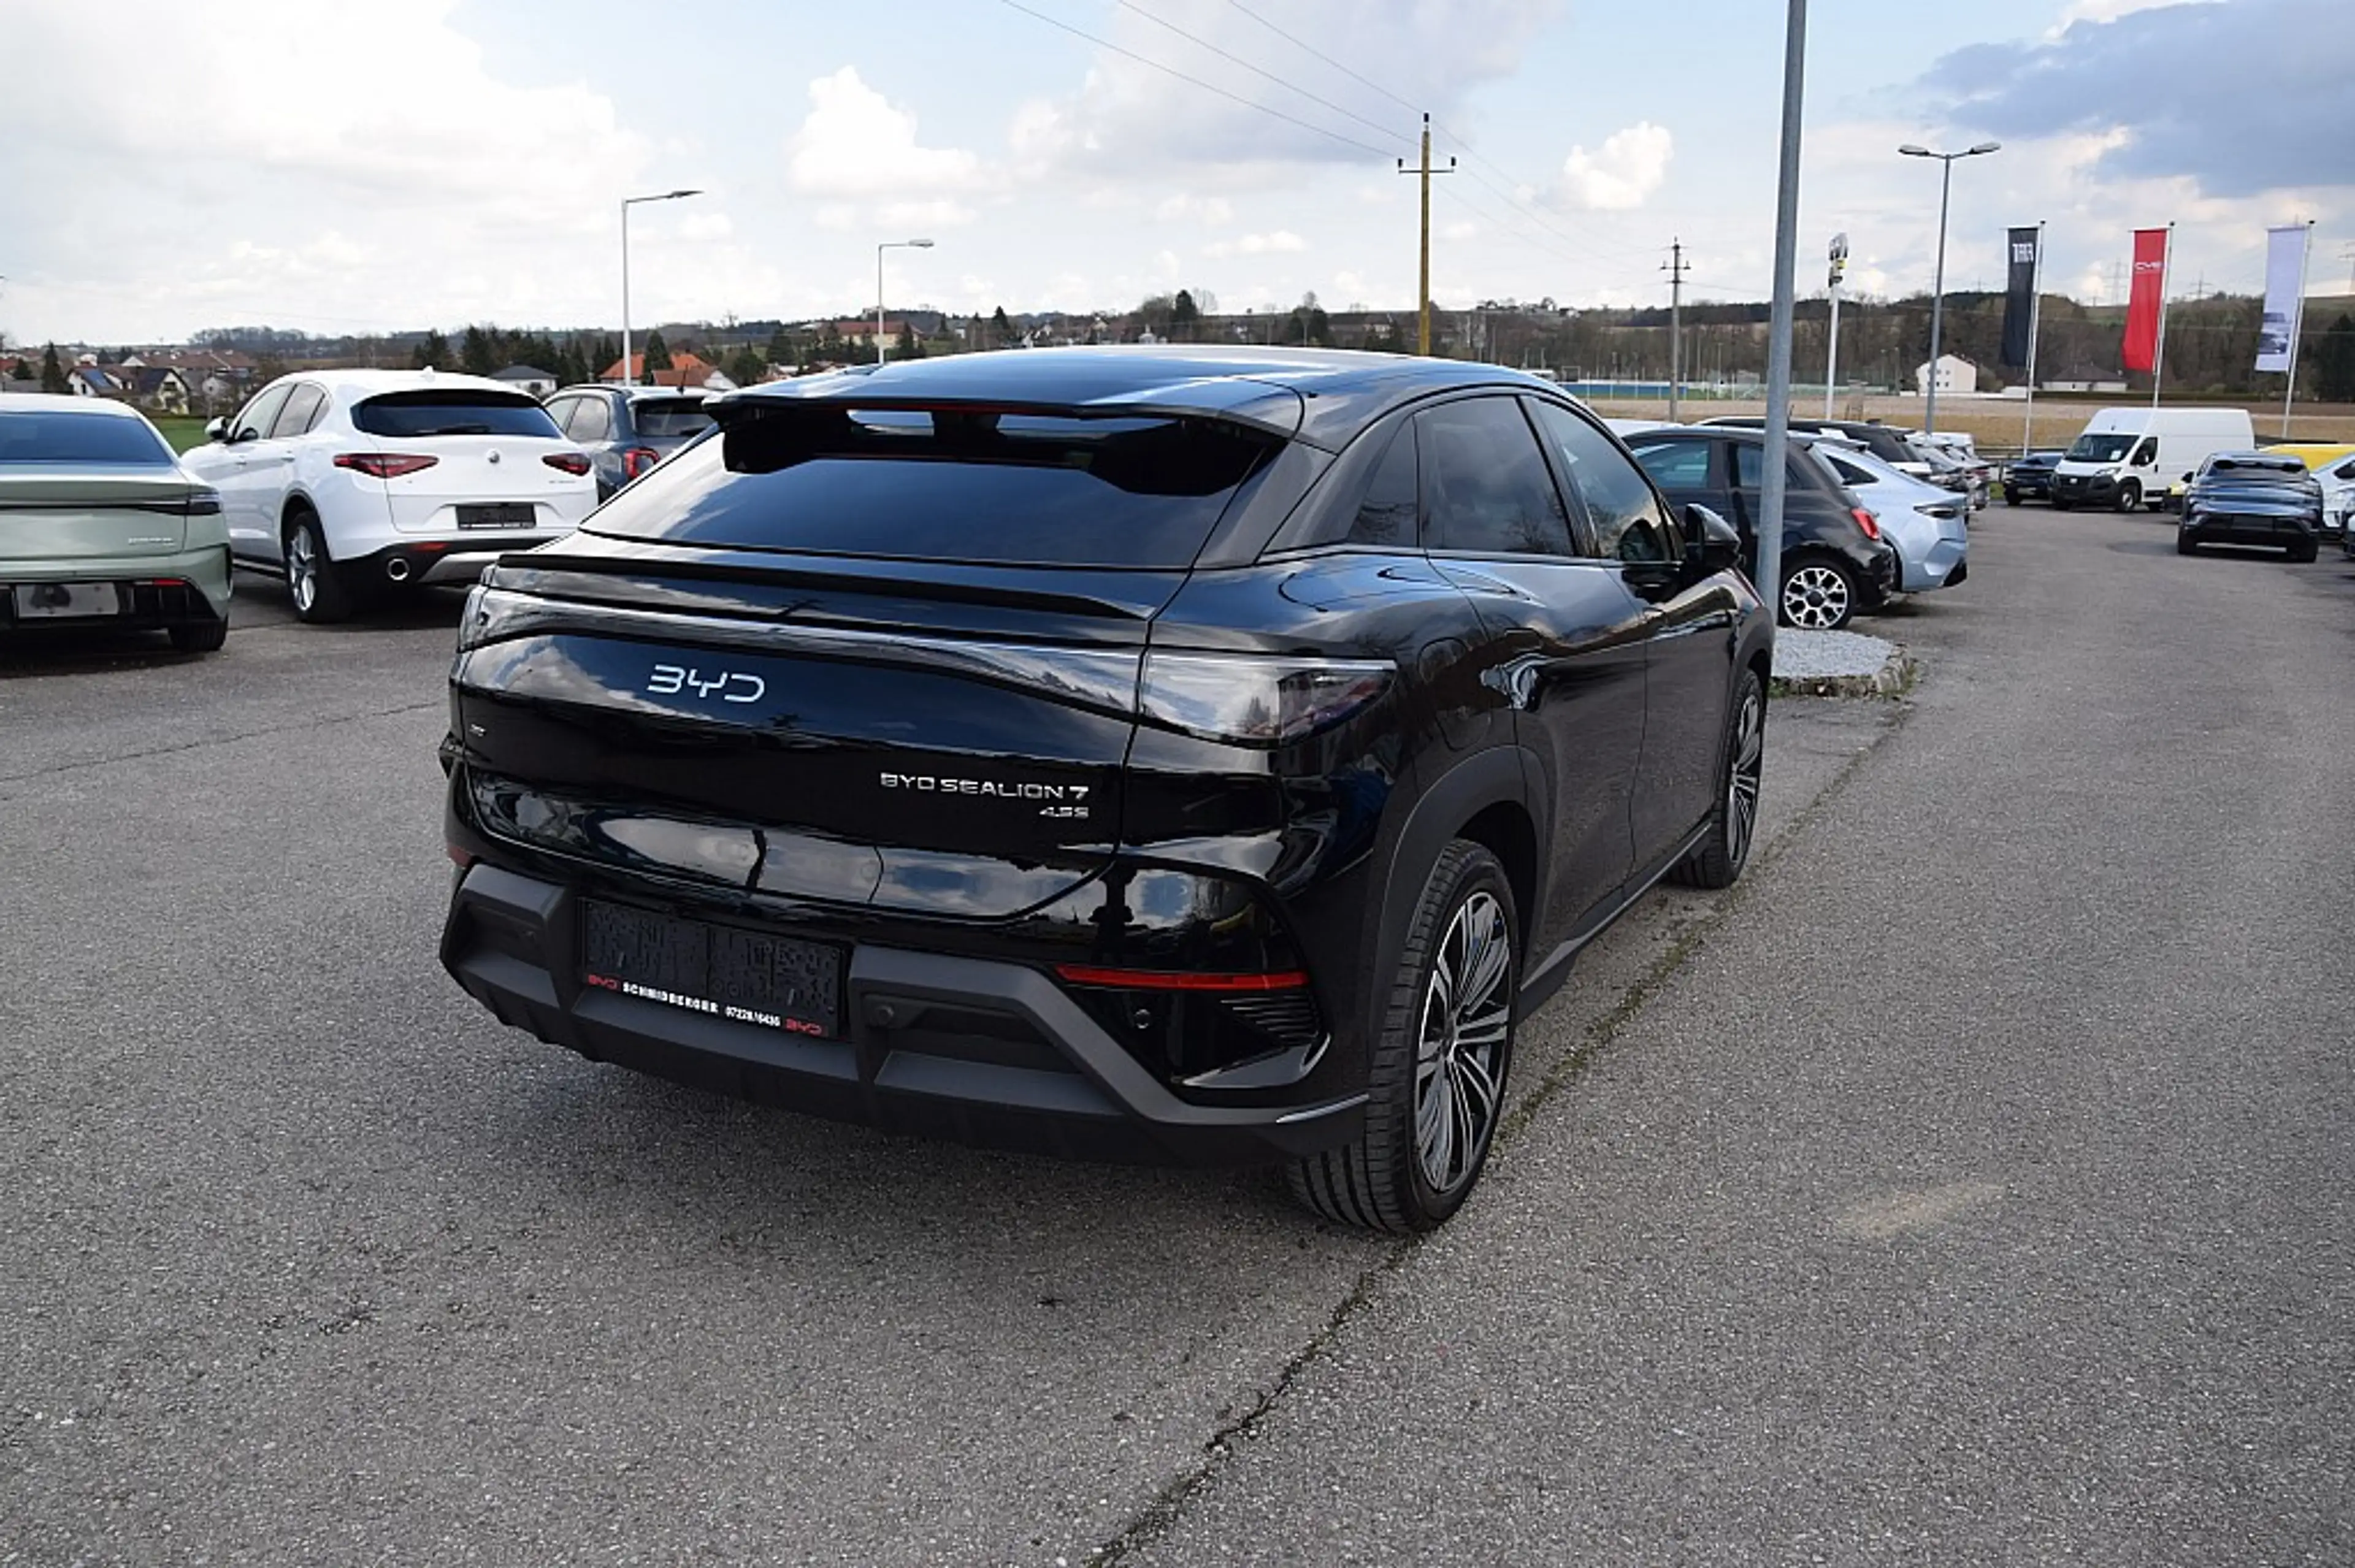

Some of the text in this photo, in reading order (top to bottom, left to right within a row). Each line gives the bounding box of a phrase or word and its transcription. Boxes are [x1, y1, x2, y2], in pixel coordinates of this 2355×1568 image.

[647, 664, 765, 702] BYD
[880, 772, 1089, 800] BYD SEALION 7
[588, 974, 618, 990] BYD
[622, 982, 719, 1014] SCHMIDBERGER
[786, 1018, 822, 1036] BYD
